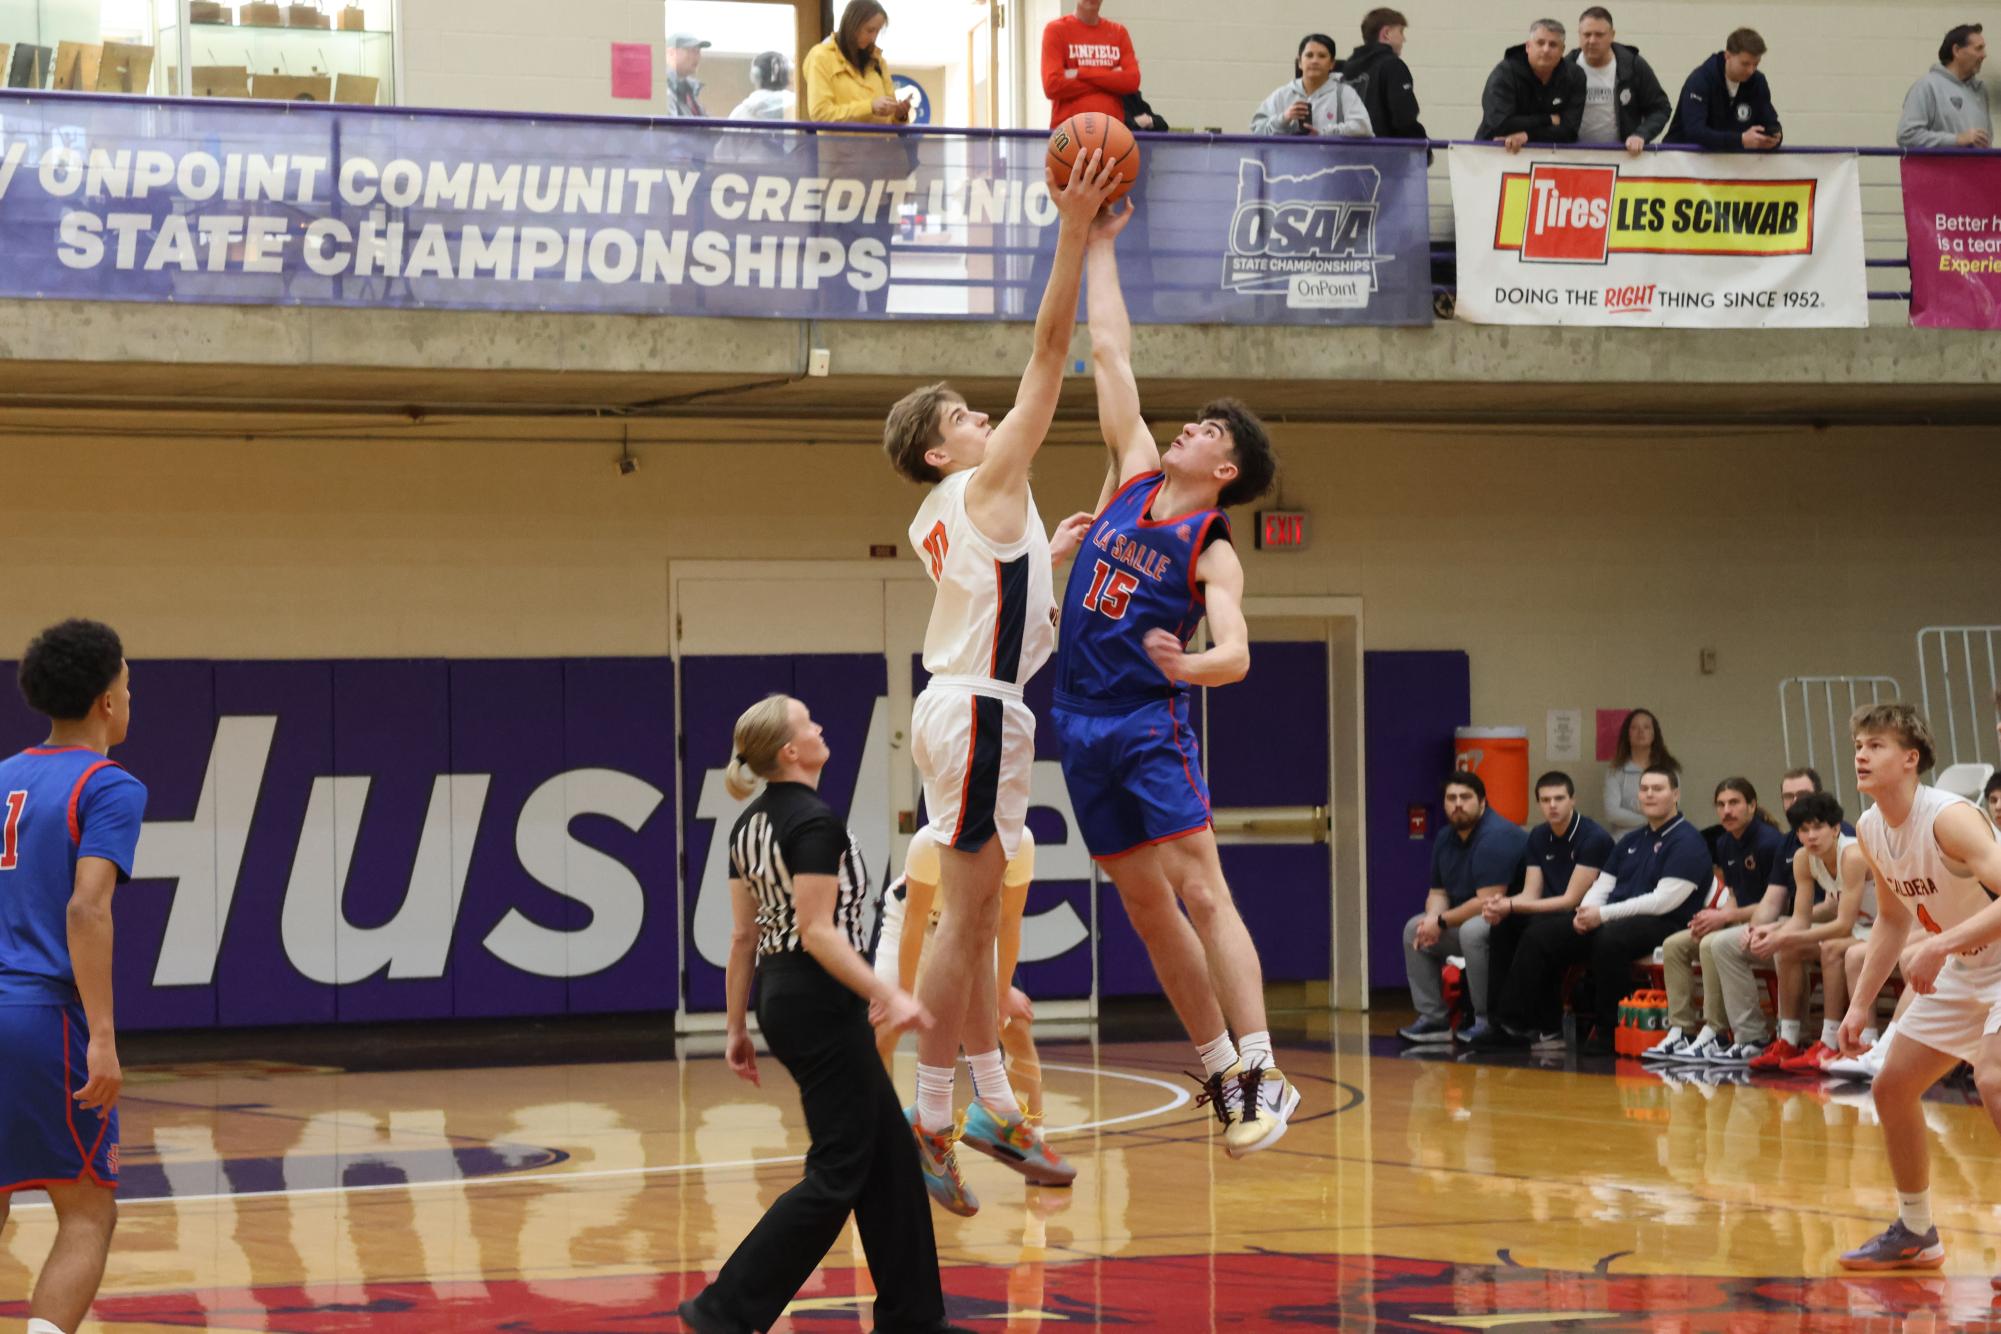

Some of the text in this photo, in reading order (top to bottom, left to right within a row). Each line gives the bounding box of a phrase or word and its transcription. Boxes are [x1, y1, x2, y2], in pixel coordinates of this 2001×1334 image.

[1069, 44, 1120, 60] LINFIELD
[39, 147, 327, 203] ONPOINT
[338, 157, 700, 215] COMMUNITY
[710, 173, 917, 225] CREDIT
[928, 178, 1060, 227] UNIO
[1534, 178, 1606, 235] Tires
[1616, 198, 1799, 235] LES SCHWAB
[1935, 213, 1988, 232] Better
[1232, 202, 1375, 258] OSAA
[1937, 233, 1950, 251] is
[1953, 239, 1964, 252] a
[57, 211, 889, 291] STATE CHAMPIONSHIPS
[1233, 258, 1371, 273] STATE CHAMPIONSHIPS
[1298, 279, 1359, 297] OnPoint
[1495, 287, 1559, 305] DOING
[1565, 289, 1599, 306] THE
[1604, 284, 1657, 307] RIGHT
[1658, 290, 1715, 308] THING
[1723, 291, 1777, 308] SINCE
[1265, 514, 1304, 545] EXIT
[1092, 520, 1172, 582] LA SALLE
[1083, 557, 1140, 620] 15
[0, 789, 28, 870] 1
